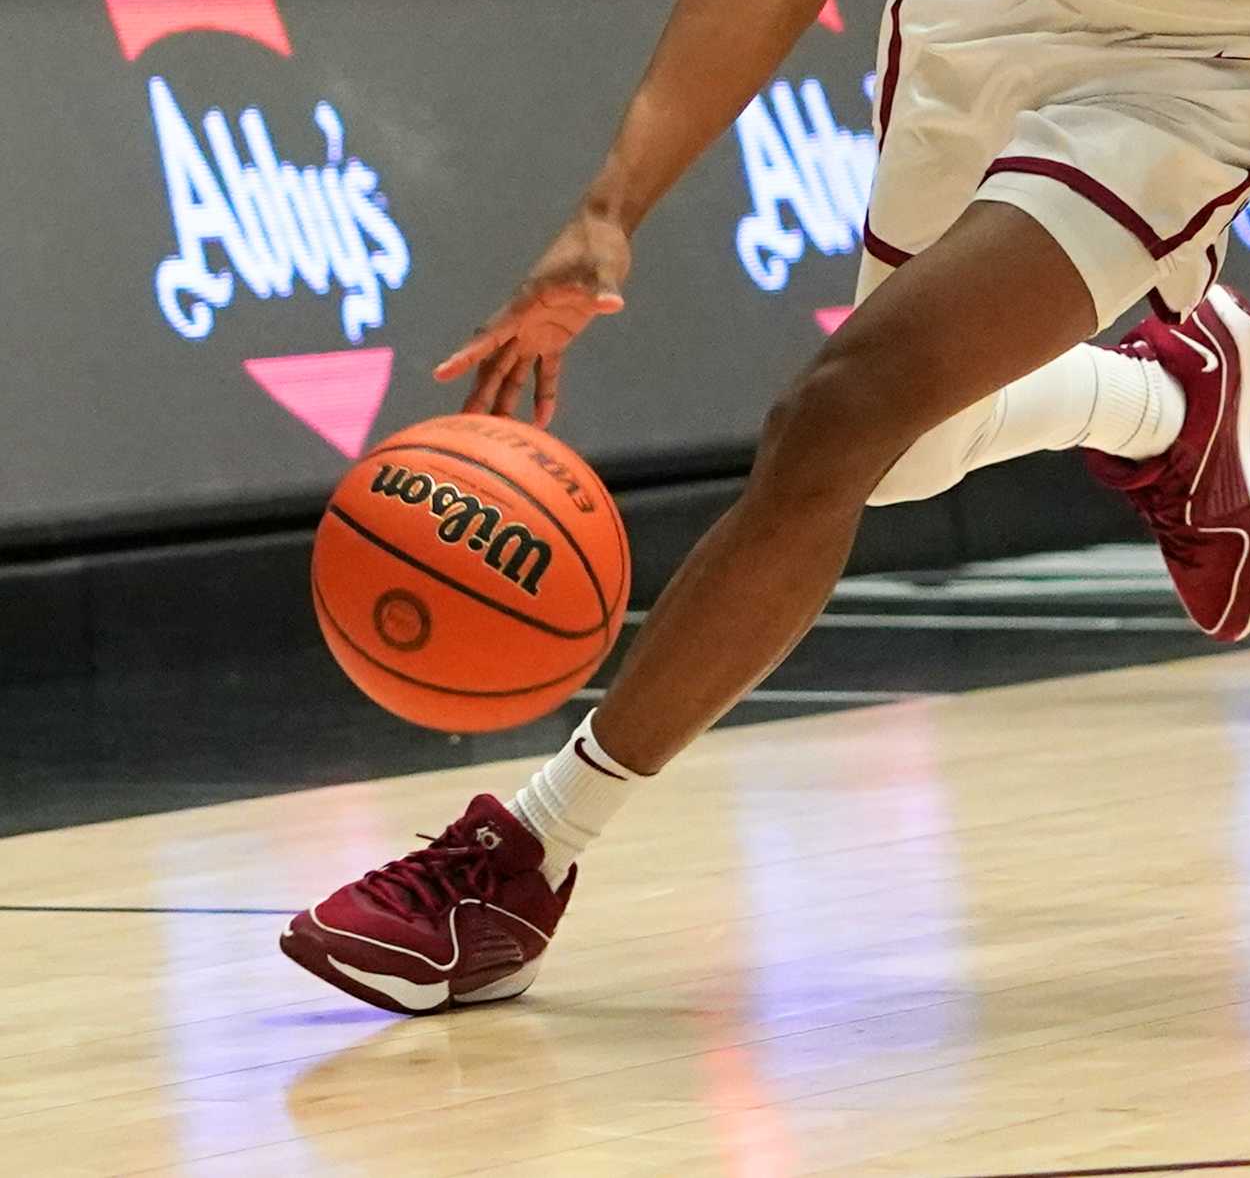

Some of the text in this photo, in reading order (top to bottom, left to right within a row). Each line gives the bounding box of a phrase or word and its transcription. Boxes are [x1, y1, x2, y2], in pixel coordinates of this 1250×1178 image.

[147, 75, 410, 344] Abby's
[735, 76, 880, 292] Abb
[370, 463, 552, 597] Wilson
